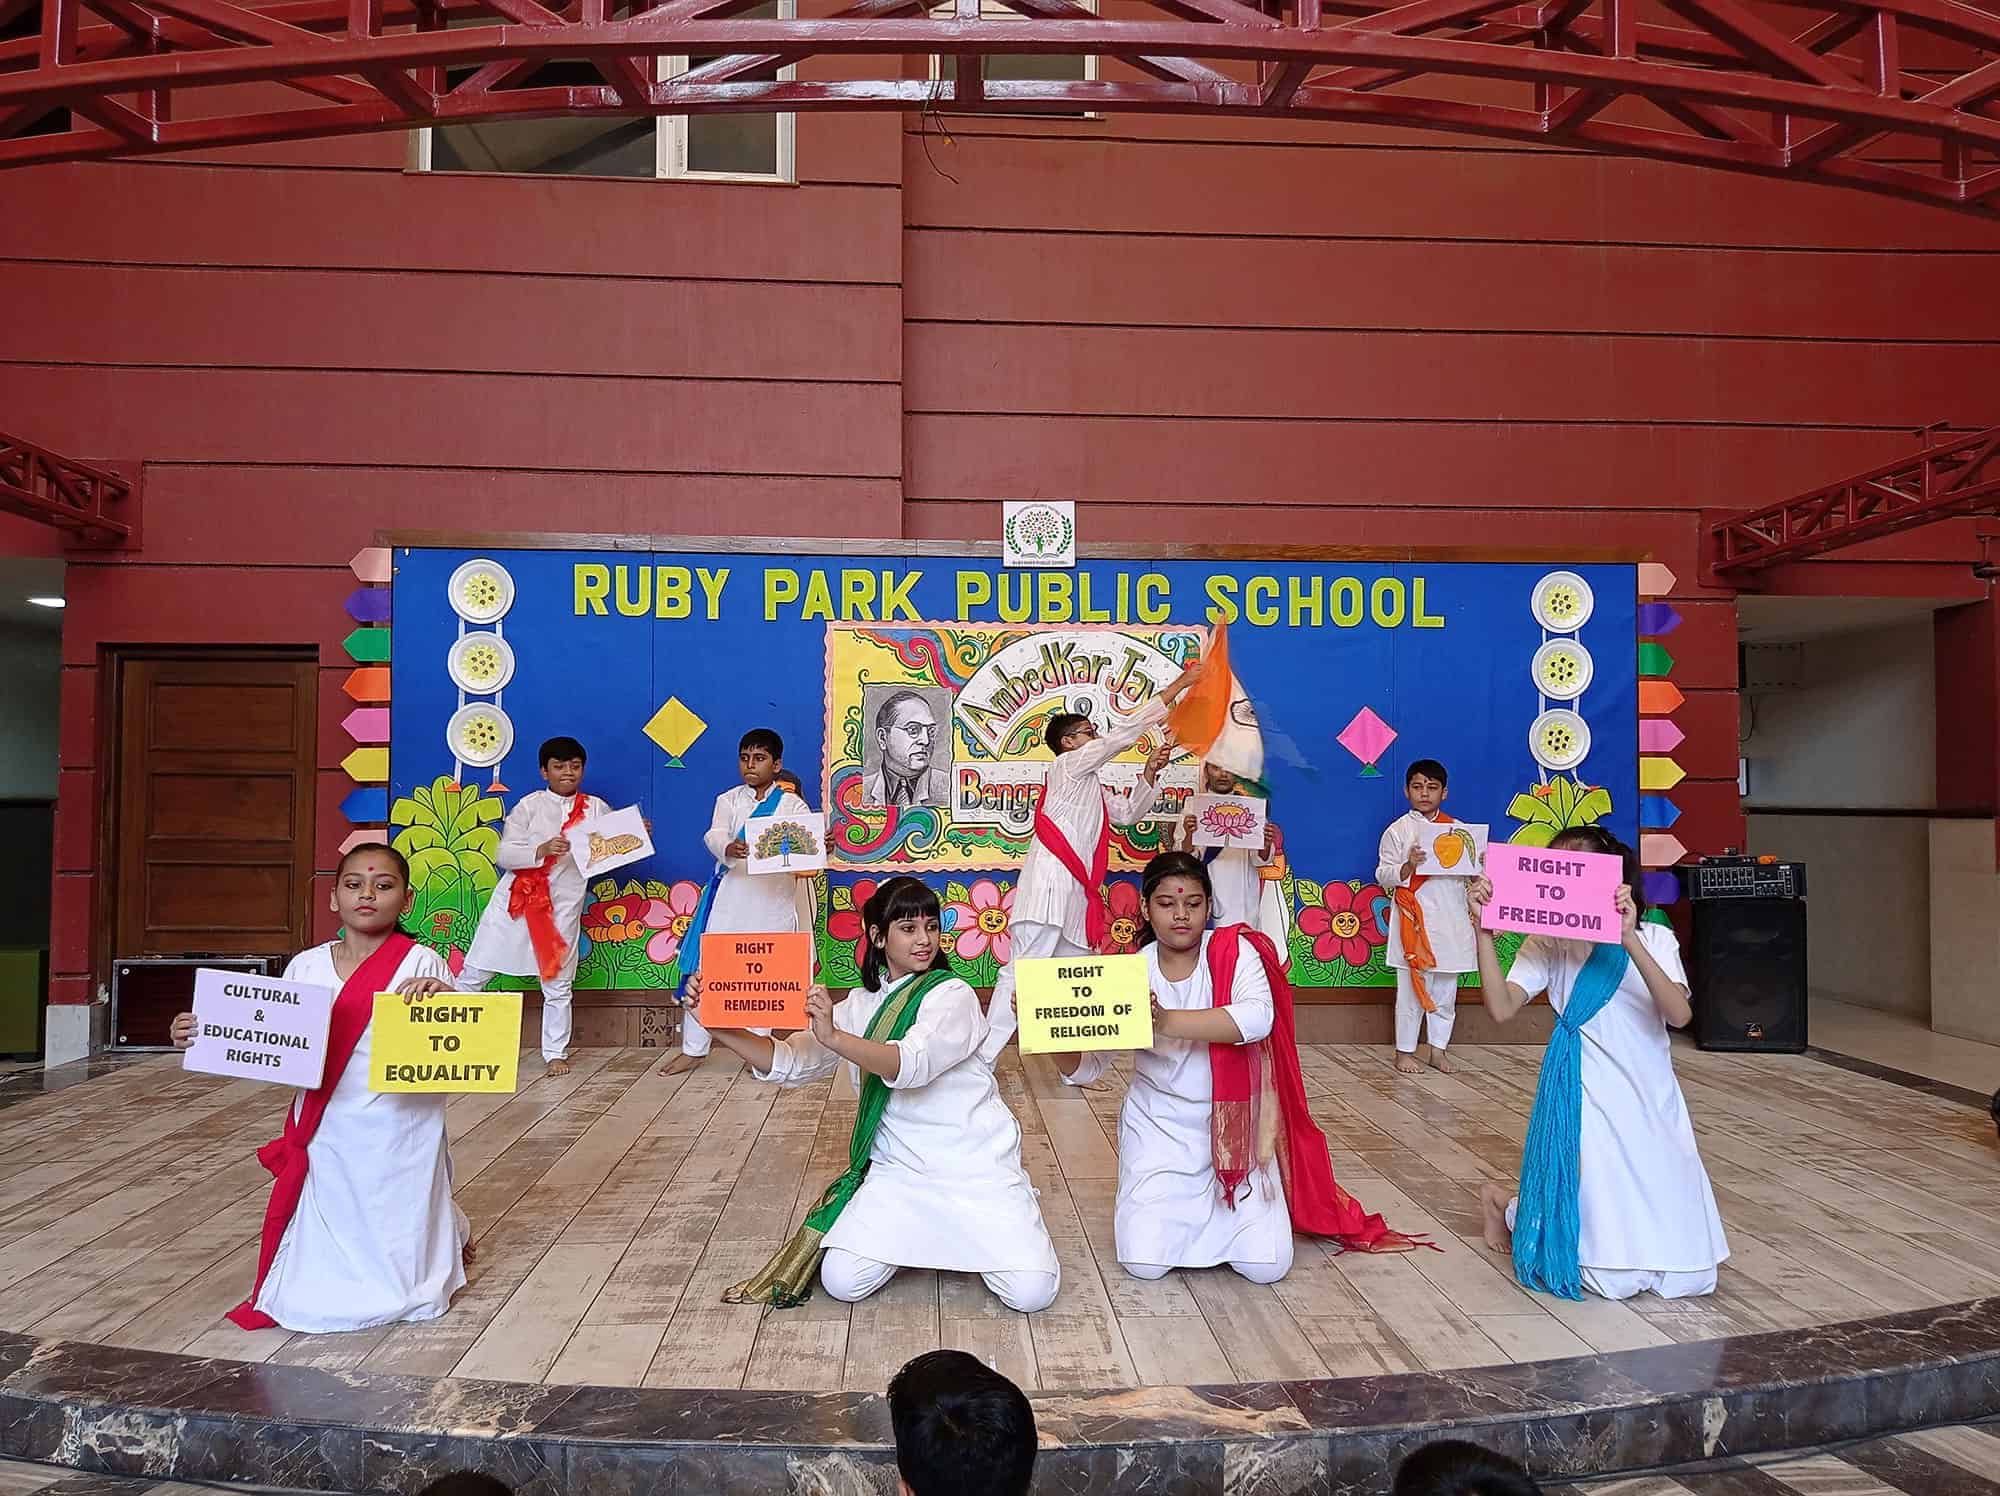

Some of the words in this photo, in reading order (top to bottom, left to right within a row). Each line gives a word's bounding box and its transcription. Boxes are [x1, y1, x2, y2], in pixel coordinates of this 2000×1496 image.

[574, 563, 731, 620] RUBY
[764, 568, 924, 621] PARK
[956, 570, 1171, 624] PUBLIC
[1204, 575, 1445, 628] SCHOOL
[1518, 856, 1586, 878] RIGHT
[1535, 884, 1566, 900] TO
[1498, 905, 1601, 930] FREEDOM
[735, 942, 775, 954] RIGHT
[745, 962, 763, 974] TO
[1057, 965, 1104, 979] RIGHT
[223, 983, 300, 1006] CULTURAL
[708, 981, 801, 992] CONSTITUTIONAL
[1071, 986, 1092, 998] TO
[724, 999, 785, 1011] REMEDIES
[1034, 1004, 1105, 1020] FREEDOM
[1112, 1003, 1133, 1016] OF
[253, 1009, 265, 1022] &
[409, 1005, 484, 1024] RIGHT
[203, 1024, 310, 1050] EDUCATIONAL
[1050, 1023, 1120, 1039] RELIGION
[428, 1034, 461, 1052] TO
[226, 1048, 281, 1068] RIGHTS
[385, 1064, 500, 1083] EQUALITY
